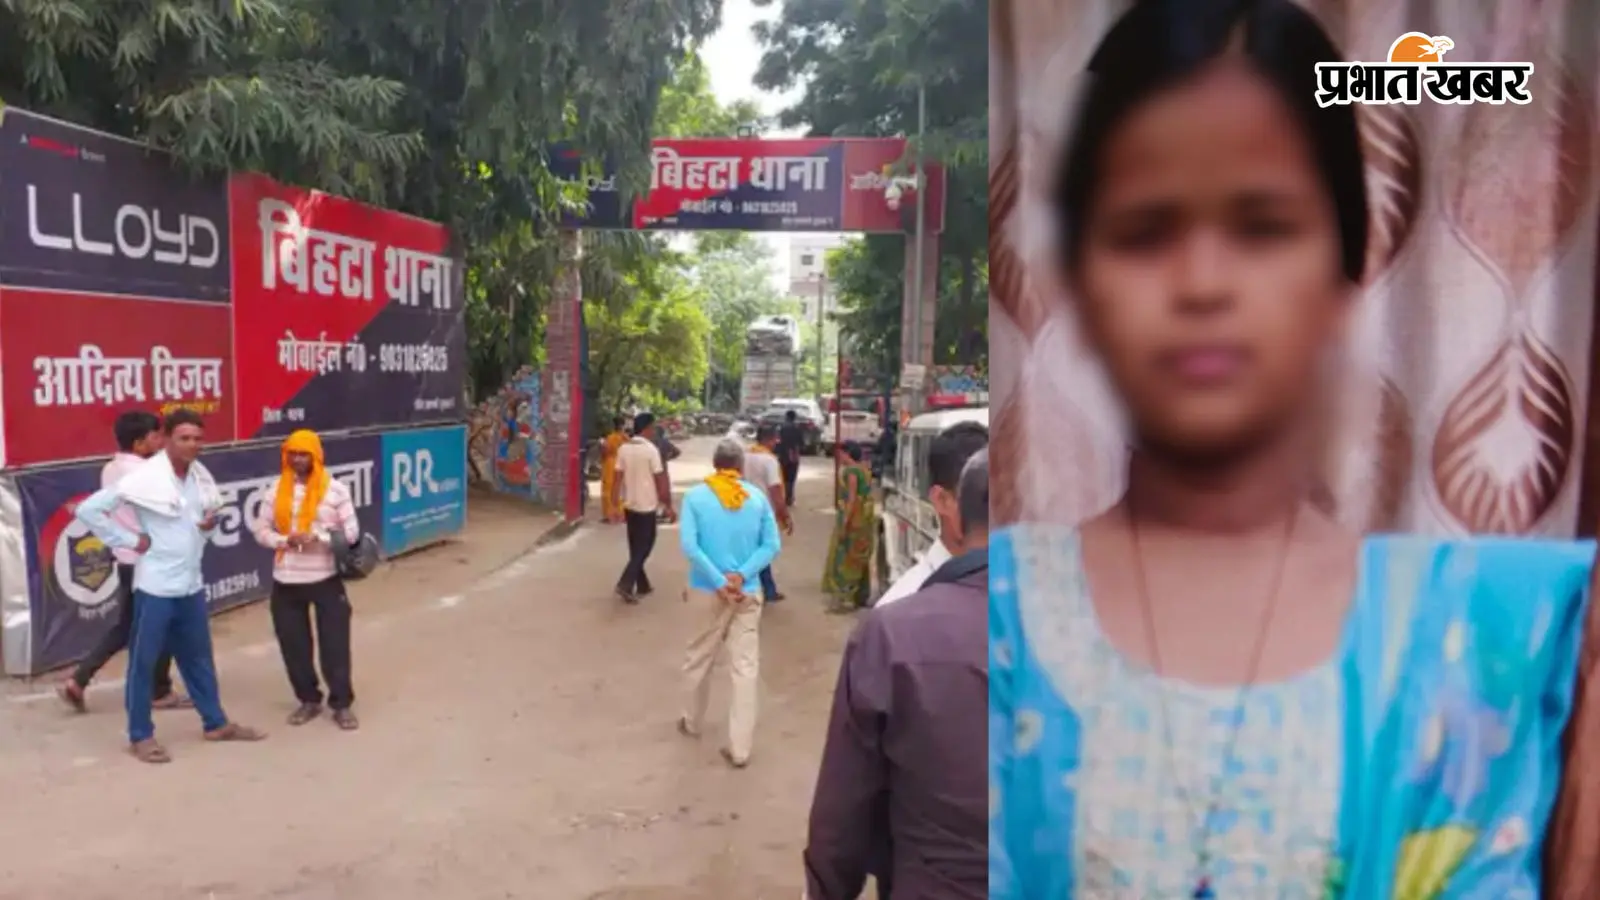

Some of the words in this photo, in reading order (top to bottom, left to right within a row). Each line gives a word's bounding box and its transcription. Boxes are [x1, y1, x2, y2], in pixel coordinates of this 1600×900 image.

[649, 147, 743, 191] बिहटा
[748, 156, 830, 192] थाना
[27, 184, 219, 268] LLOYD
[258, 198, 377, 301] बिहटा
[384, 245, 454, 310] थाना
[33, 344, 147, 406] आदित्य
[150, 345, 222, 402] विजन
[389, 448, 439, 503] RR
